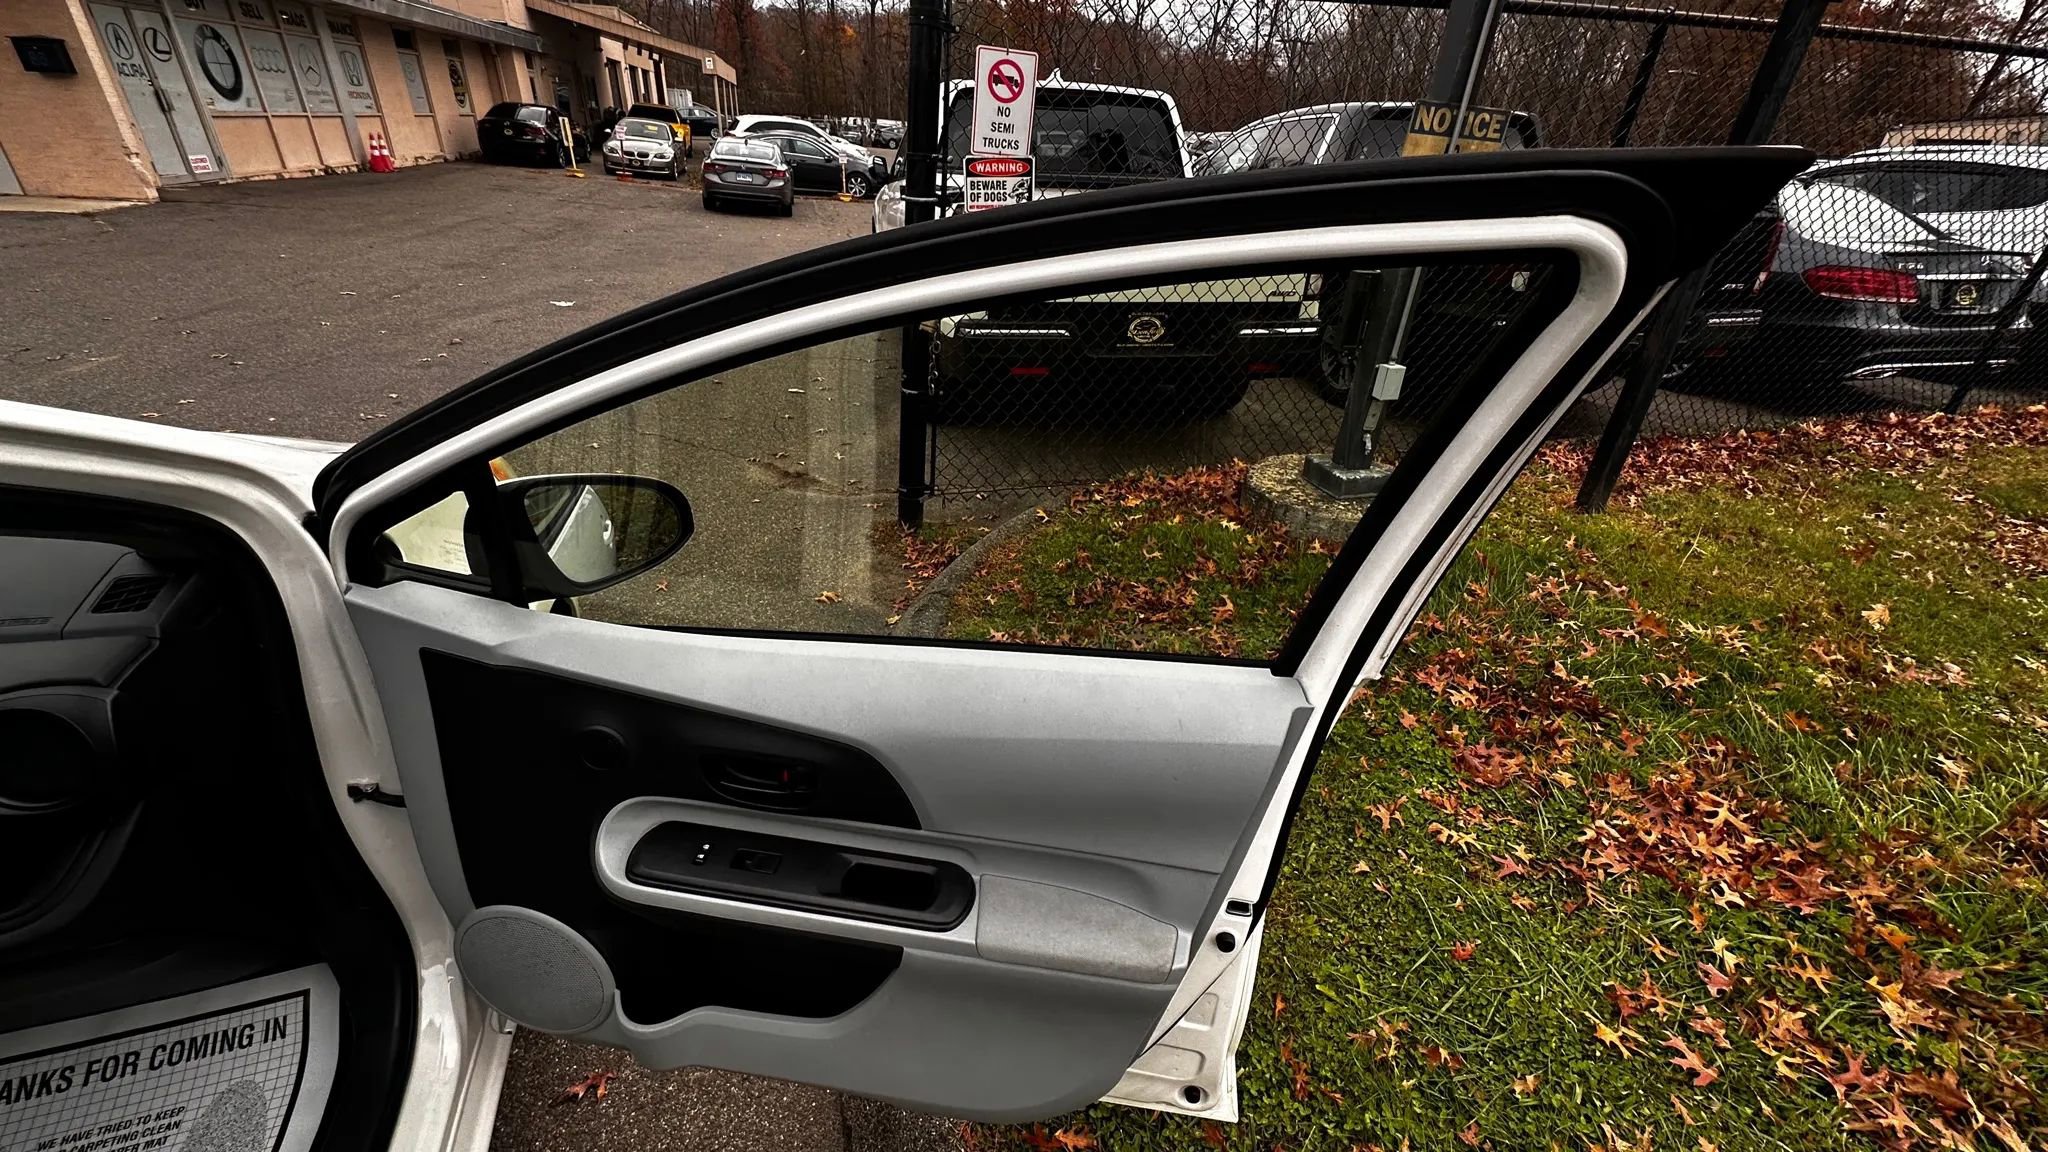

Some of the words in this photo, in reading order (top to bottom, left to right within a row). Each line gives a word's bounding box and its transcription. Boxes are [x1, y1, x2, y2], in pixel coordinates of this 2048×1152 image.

[240, 2, 264, 20] SELL
[116, 62, 148, 78] ACURA
[997, 106, 1011, 118] NO
[990, 121, 1015, 134] SEMI
[1414, 104, 1506, 139] NOICE
[982, 137, 1020, 150] TRUCKS
[976, 163, 1024, 173] WARNING
[970, 180, 1008, 191] BEWARE
[969, 191, 982, 203] OF
[984, 191, 1008, 203] DOGS
[82, 1050, 140, 1087] FOR
[149, 1023, 255, 1071] COMING
[263, 1015, 288, 1044] IN
[37, 1138, 58, 1152] WE
[60, 1129, 94, 1146] HAVE
[97, 1119, 132, 1139] TRIED
[134, 1113, 152, 1127] TO
[154, 1106, 186, 1122] KEEP
[67, 1130, 139, 1152] CARPETING
[141, 1119, 182, 1138] CLEAN
[143, 1135, 171, 1150] MAT
